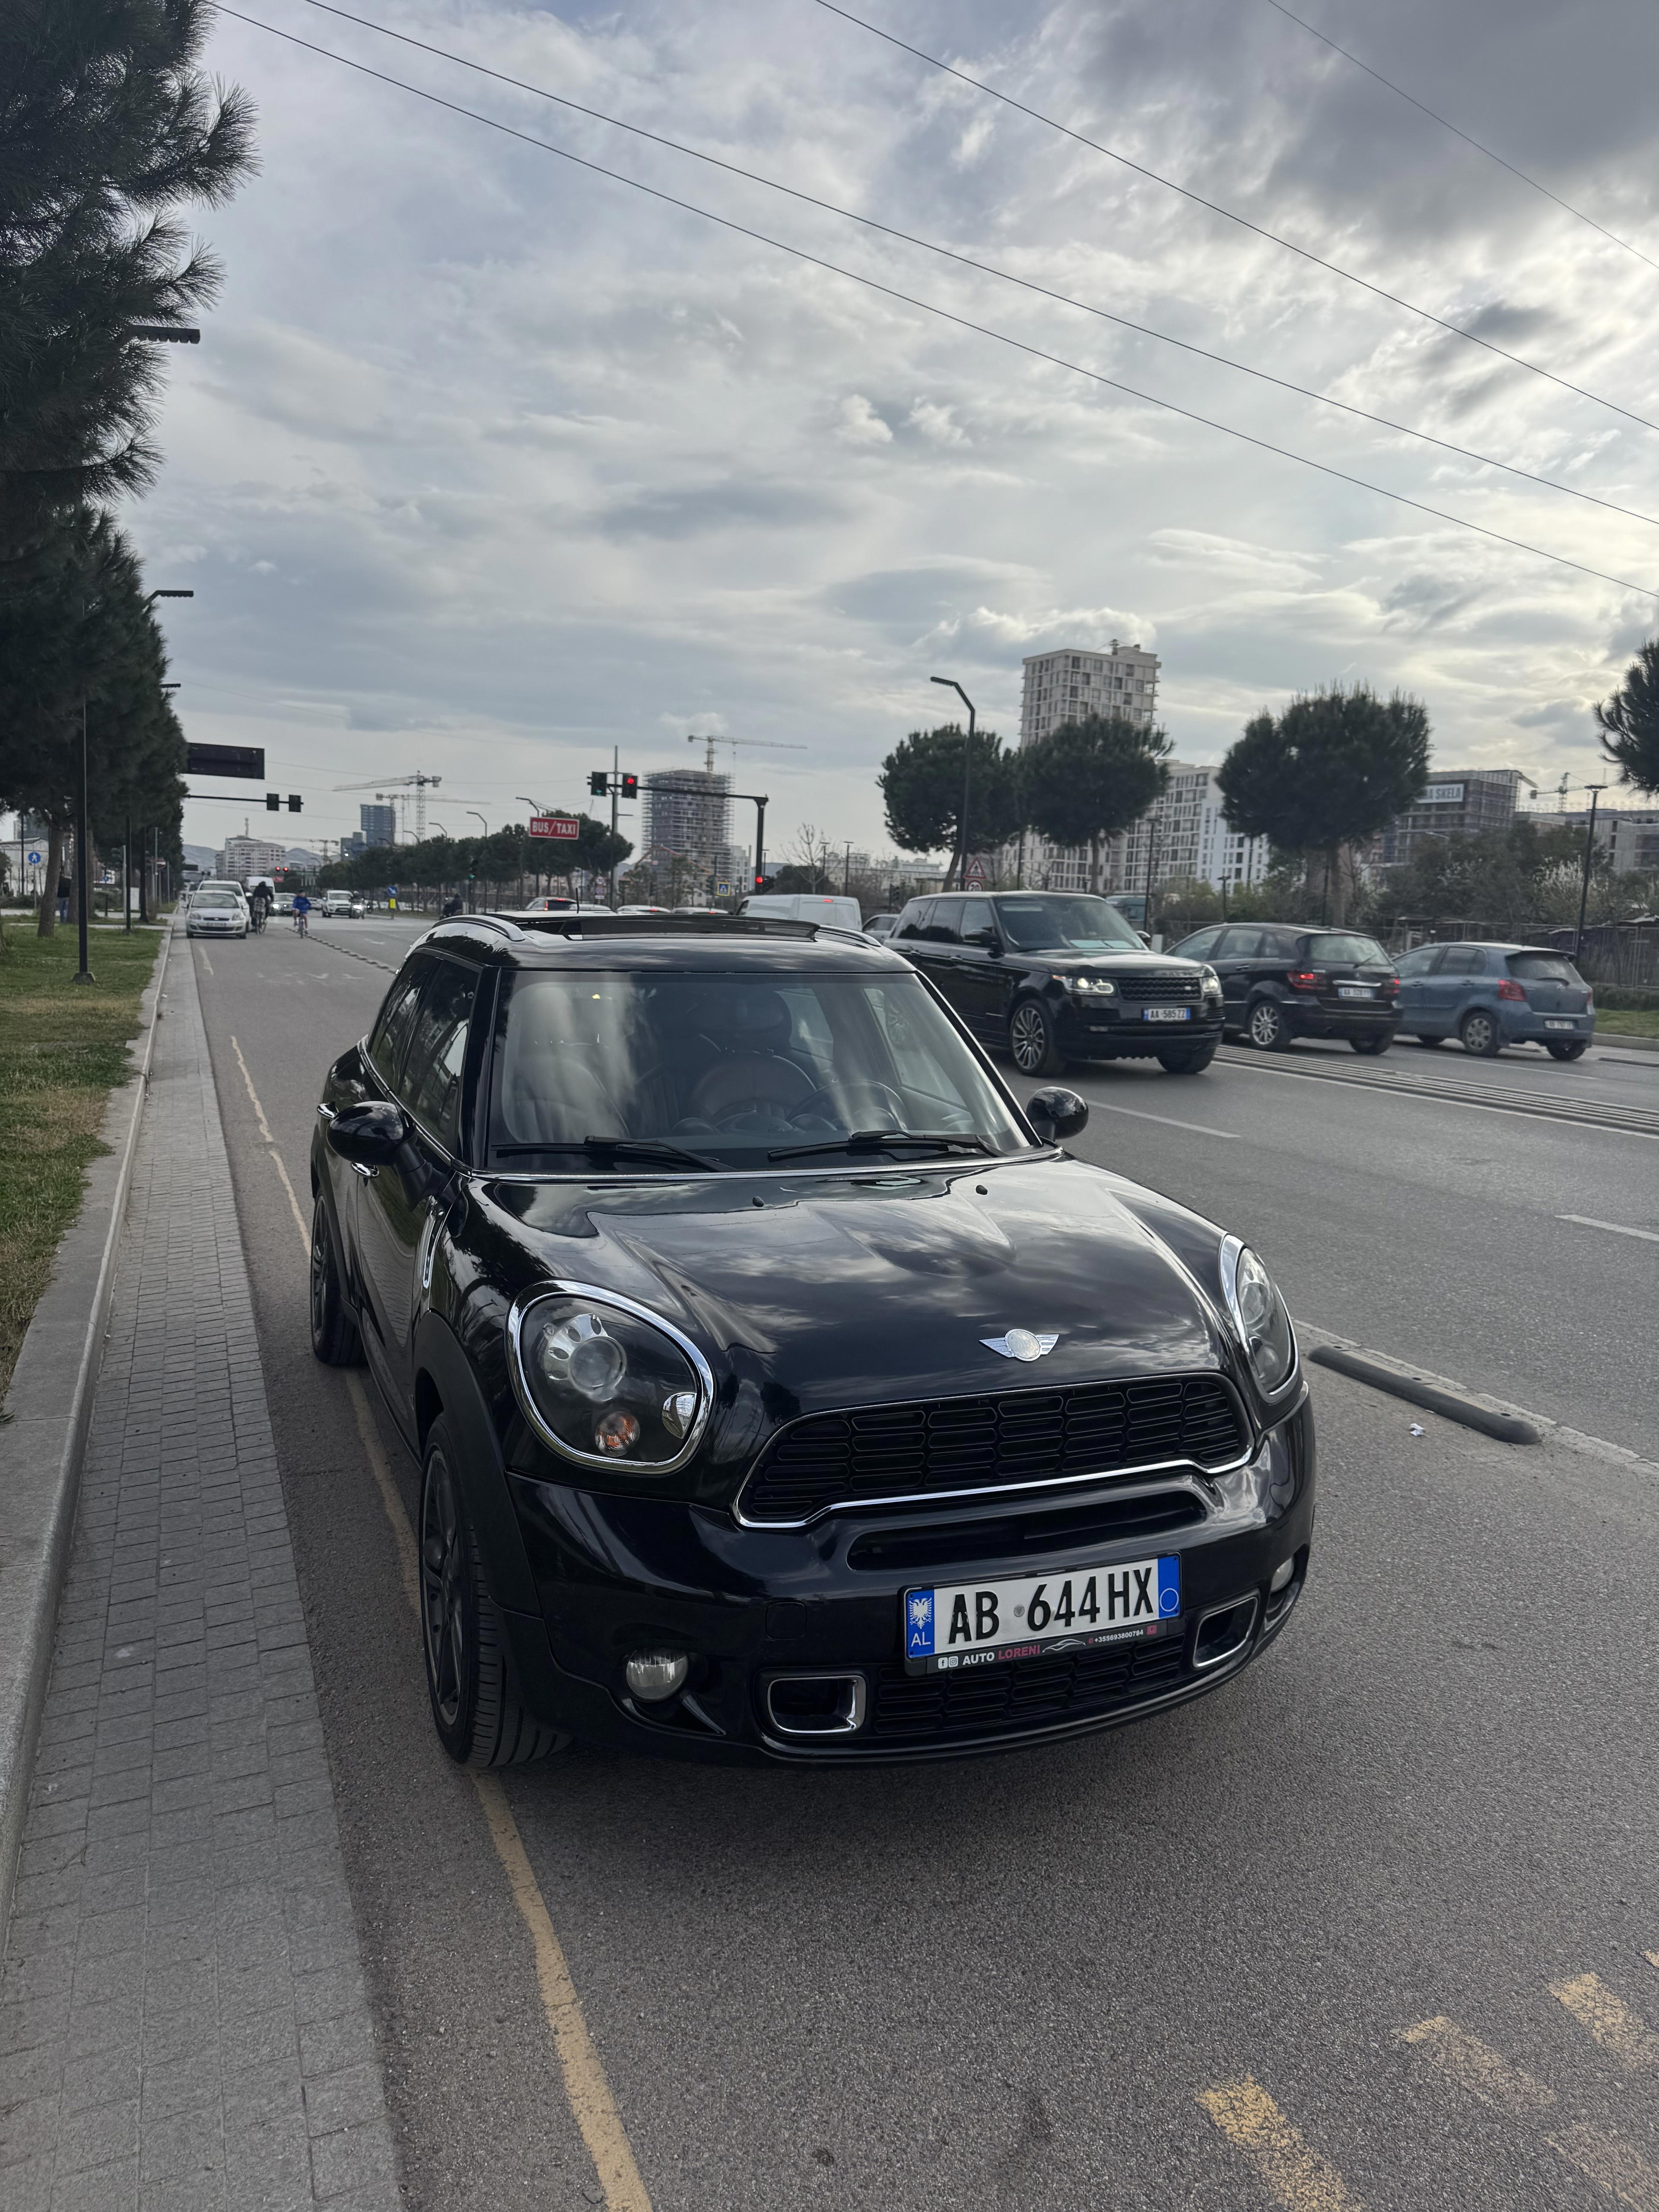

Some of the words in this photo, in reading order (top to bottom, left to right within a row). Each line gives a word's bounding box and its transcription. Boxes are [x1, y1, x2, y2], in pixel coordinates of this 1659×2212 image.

[1435, 788, 1461, 799] SKELA
[532, 821, 575, 835] BUS/TAXI
[1150, 1010, 1159, 1019] AA
[948, 1591, 999, 1644] AB
[911, 1632, 931, 1647] AL
[962, 1652, 995, 1665] AUTO
[998, 1645, 1040, 1660] LORENI
[1094, 1629, 1144, 1643] +355693800784
